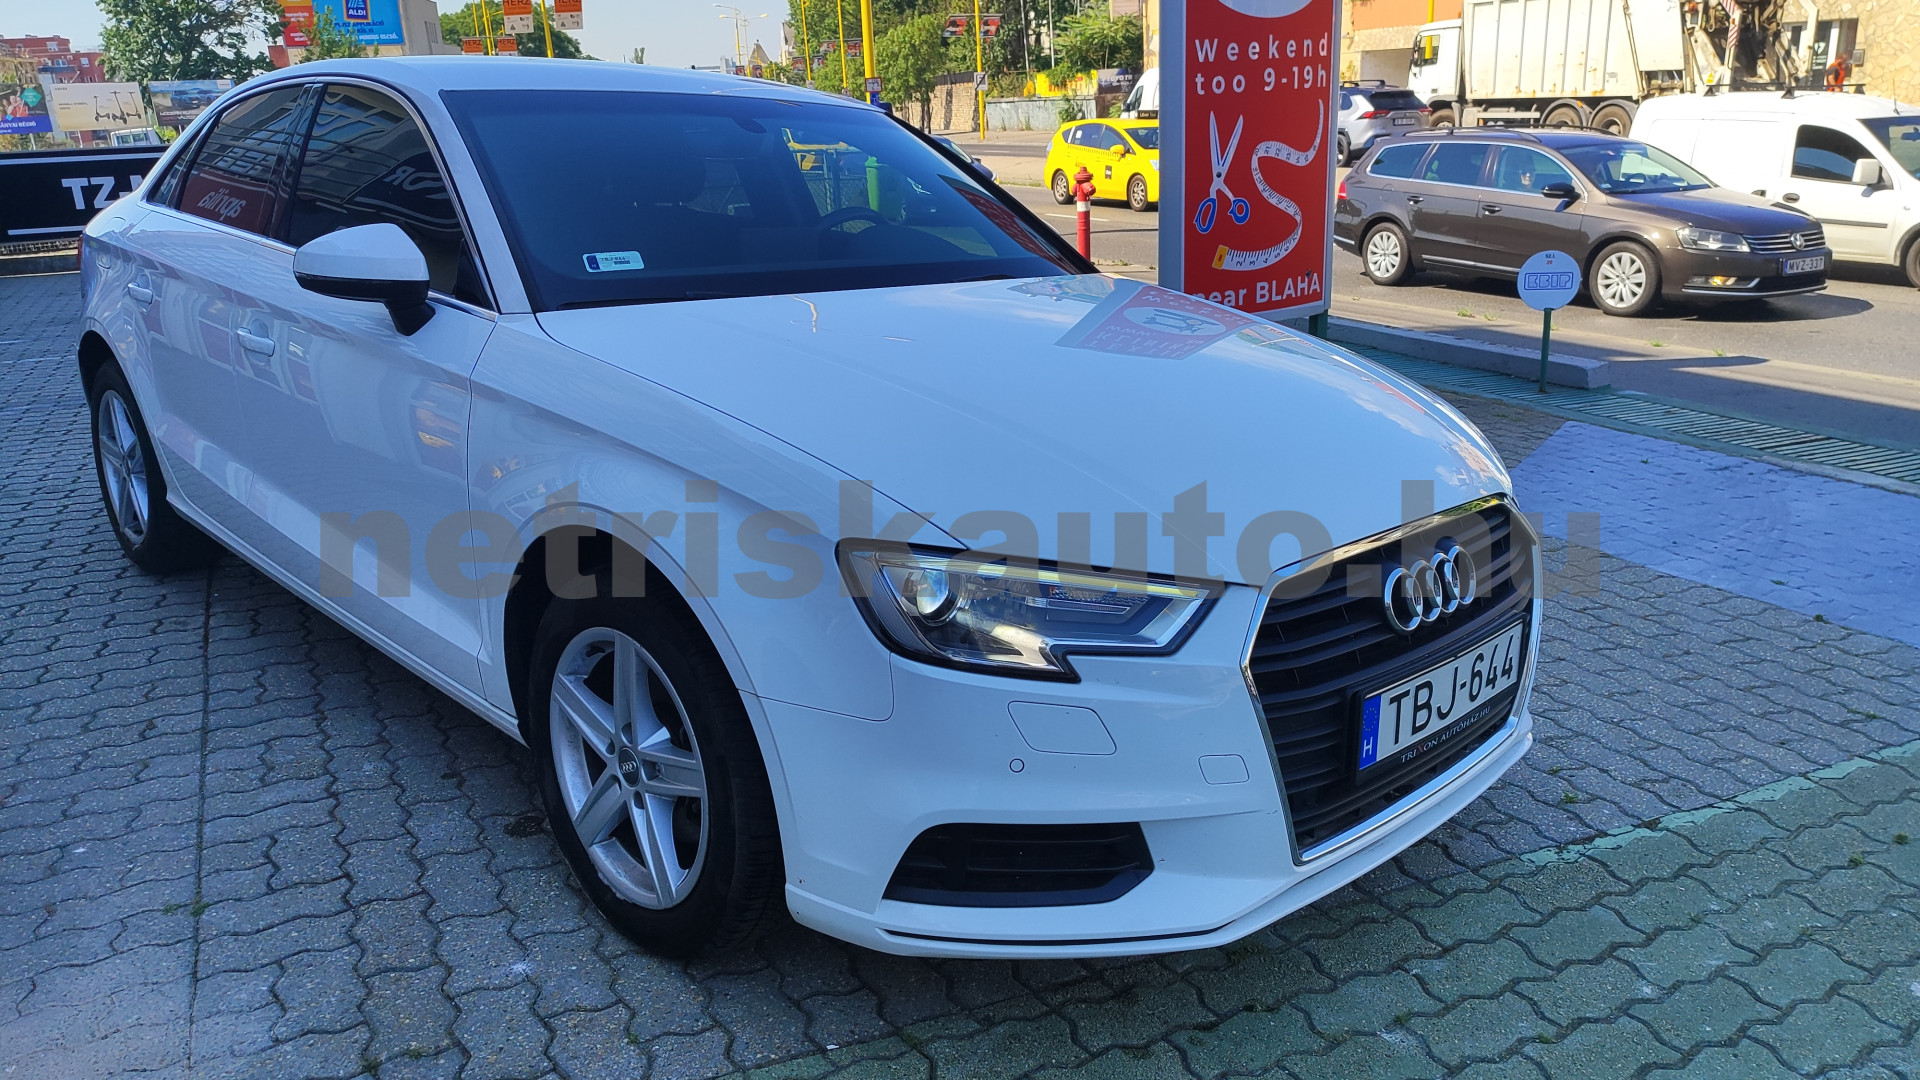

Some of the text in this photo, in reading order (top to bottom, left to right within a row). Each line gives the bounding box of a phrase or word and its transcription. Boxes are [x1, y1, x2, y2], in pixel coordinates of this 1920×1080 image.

[1194, 32, 1328, 63] Weekend
[1195, 64, 1326, 95] too 9-19h
[1788, 257, 1824, 271] MVZ-337
[1388, 633, 1514, 746] TBJ-644
[1362, 736, 1373, 758] H
